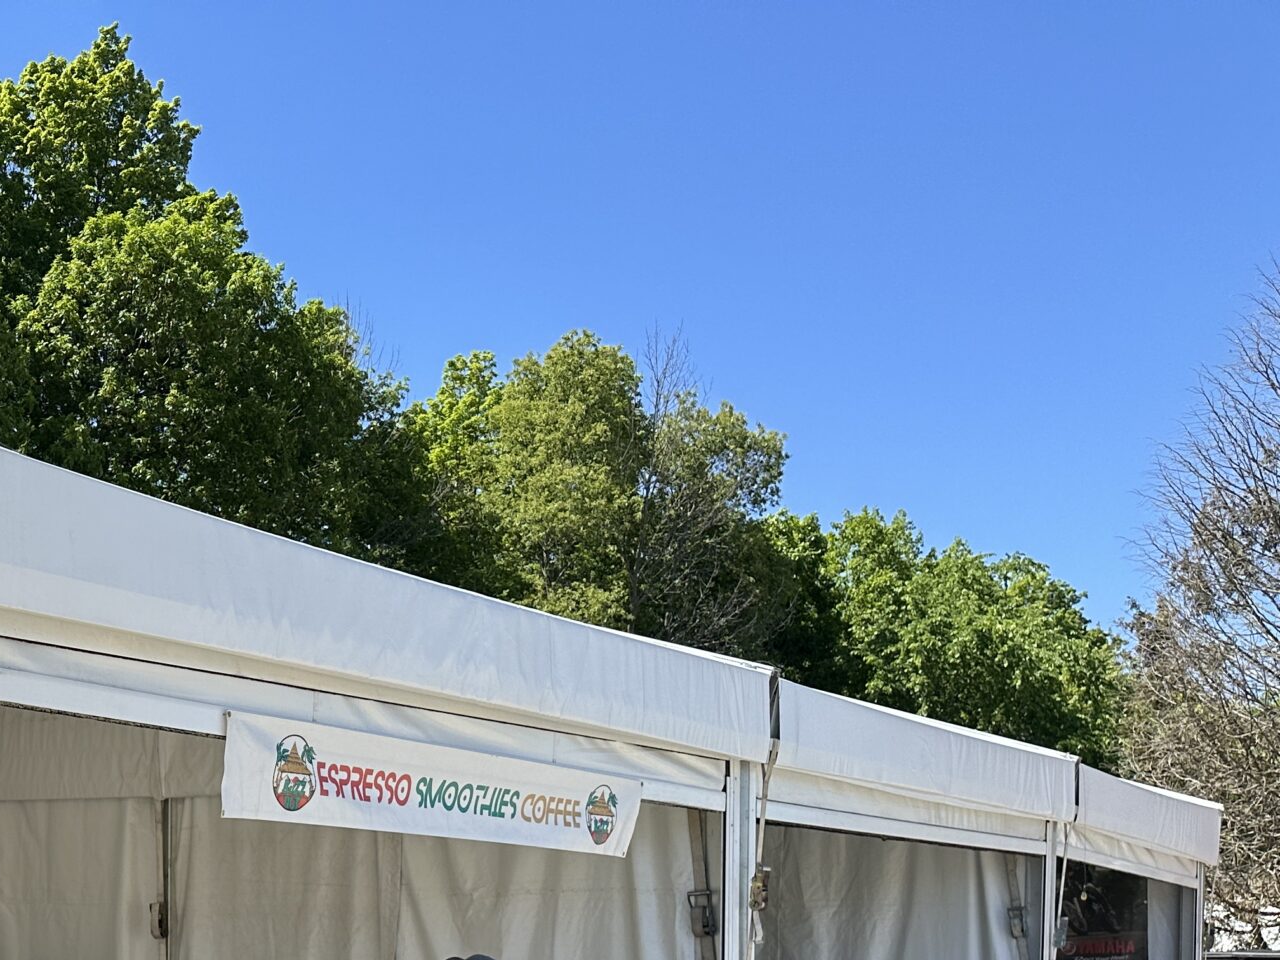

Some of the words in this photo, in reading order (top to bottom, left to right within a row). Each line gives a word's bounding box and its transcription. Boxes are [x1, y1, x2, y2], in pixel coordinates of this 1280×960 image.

[316, 761, 412, 806] ESPRESSO
[415, 776, 520, 819] SMOOTHIES
[520, 793, 582, 828] COFFEE
[1077, 940, 1136, 955] YAMAHA
